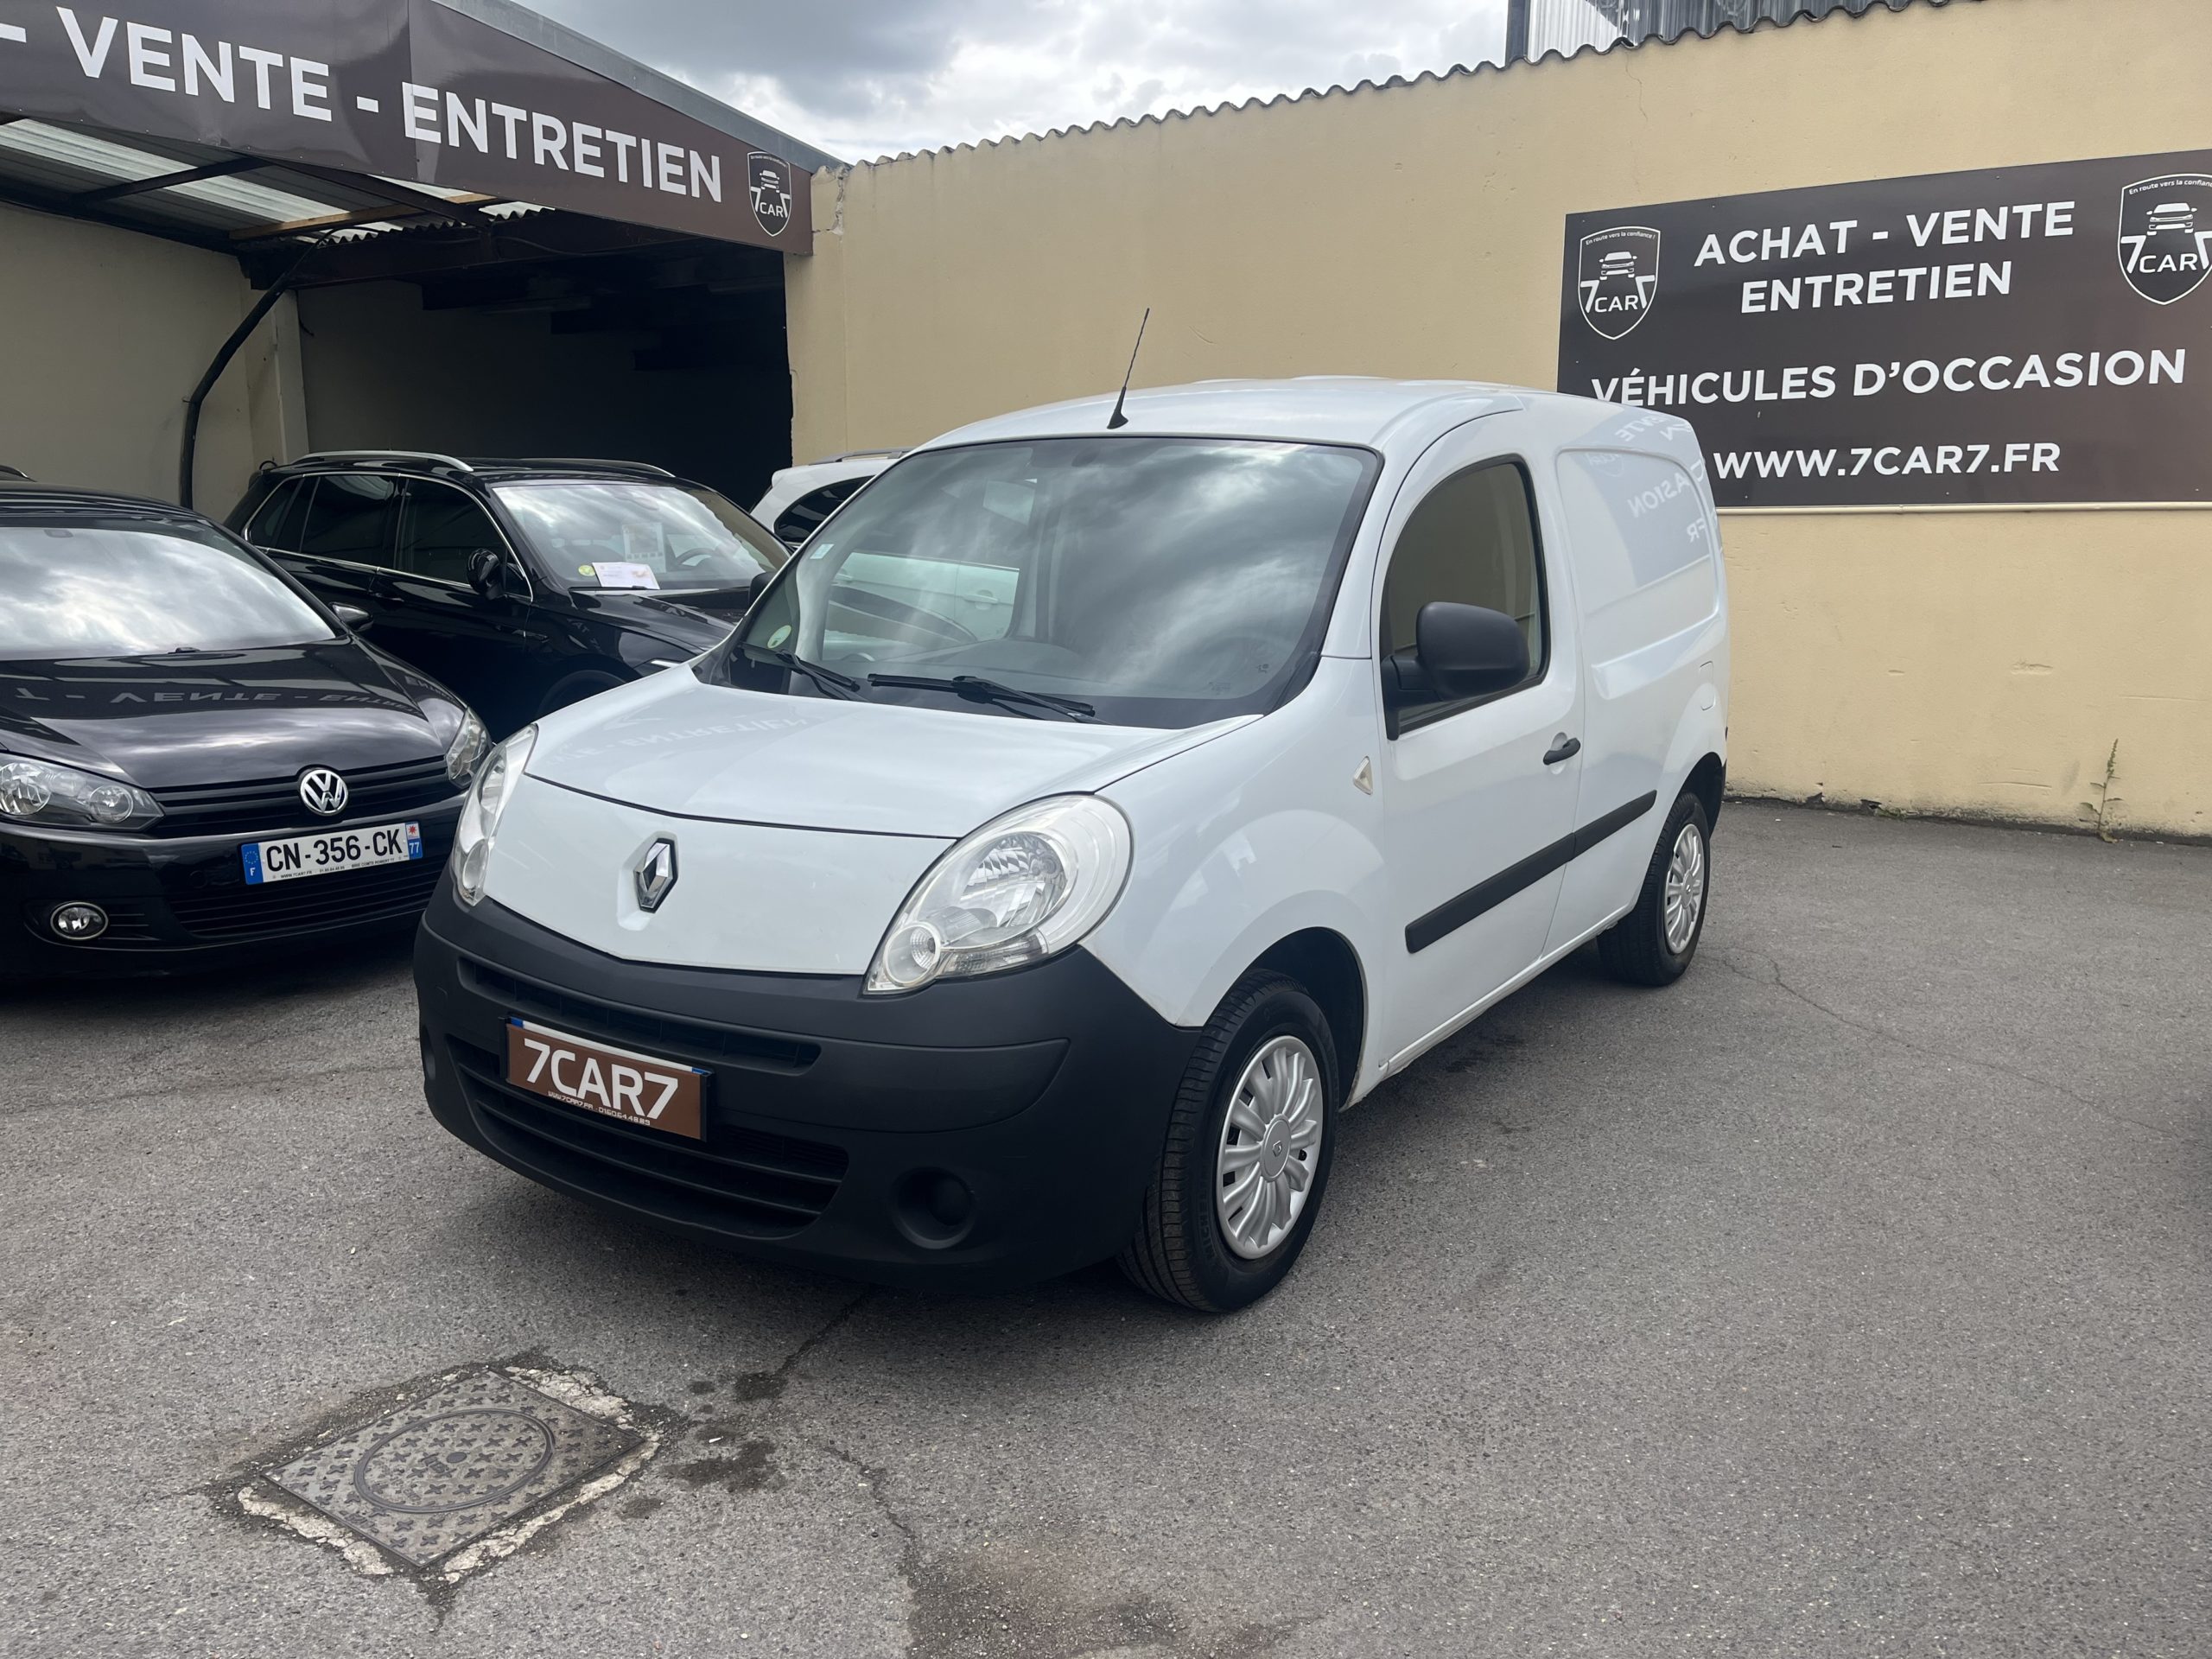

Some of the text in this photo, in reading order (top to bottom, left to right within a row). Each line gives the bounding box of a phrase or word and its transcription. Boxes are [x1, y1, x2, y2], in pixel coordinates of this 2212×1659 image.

[55, 6, 333, 123] VENTE
[402, 81, 721, 203] ENTRETIEN
[2139, 183, 2158, 192] route
[1593, 234, 1608, 243] route
[1626, 231, 1653, 239] confiance
[1694, 219, 1858, 267] ACHAT
[1905, 200, 2075, 247] VENTE
[1740, 260, 2012, 314] ENTRETIEN
[1591, 364, 1836, 407] VÉHICULES
[1713, 442, 2061, 480] WWW.7CAR7.FR
[266, 829, 403, 872] CN-356-CK
[409, 841, 420, 854] 77
[250, 868, 256, 876] F
[524, 1038, 679, 1120] 7CAR7
